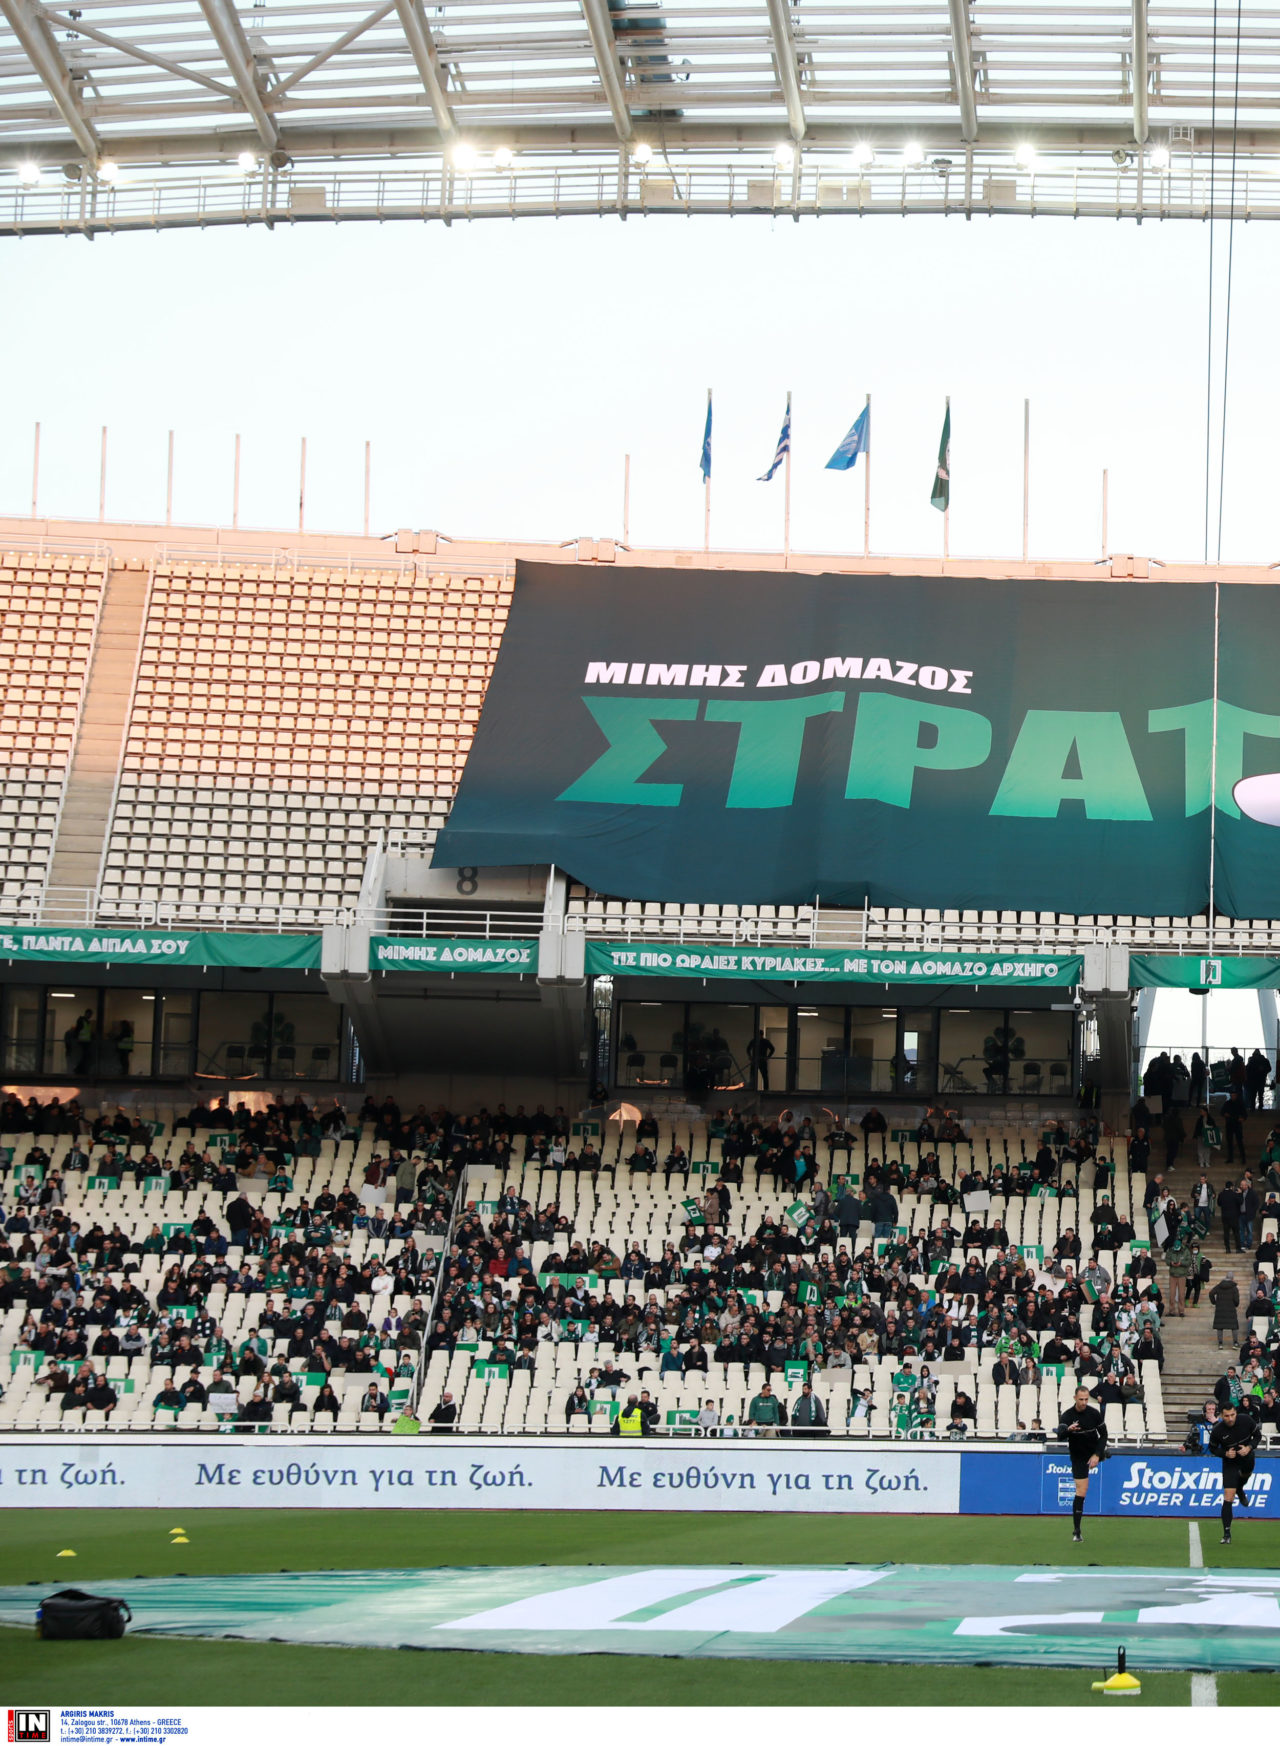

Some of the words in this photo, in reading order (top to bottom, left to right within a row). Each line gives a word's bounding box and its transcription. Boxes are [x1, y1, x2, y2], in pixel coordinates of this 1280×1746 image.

[585, 661, 748, 688] ΜΙΜΗΣ
[756, 656, 974, 695] ΔΟΜΑΖΟΣ
[456, 867, 479, 895] 8
[22, 936, 85, 951] ΠΑΝΤΑ
[88, 938, 147, 953] ΔΙΠΛΑ
[150, 939, 190, 954] ΣΟΥ
[378, 945, 437, 960] ΜΙΜΗΣ
[440, 947, 531, 963] ΔΟΜΑΖΟΣ
[611, 951, 637, 966] ΤΙΣ
[640, 953, 672, 967] ΠΙΟ
[676, 954, 738, 970] ΩΡΑΙΕΣ
[741, 956, 840, 973] ΚΥΡΙΑΚΕΣ...
[844, 958, 867, 973] ΜΕ
[871, 959, 907, 974] ΤΟΝ
[910, 960, 987, 976] ΔΟΜΑΖΟ
[990, 962, 1059, 977] ΑΡΧΗΓΟ
[17, 1468, 48, 1486] τη
[62, 1463, 126, 1489] ζωή.
[195, 1463, 241, 1486] Με
[253, 1462, 358, 1486] ευθύνη
[370, 1469, 414, 1492] για
[427, 1469, 457, 1486] τη
[470, 1463, 533, 1490] ζωή.
[597, 1465, 642, 1488] Με
[653, 1465, 756, 1489] ευθύνη
[767, 1472, 811, 1495] για
[822, 1474, 854, 1491] τη
[865, 1468, 929, 1494] ζωή.
[1046, 1464, 1099, 1474] Stoixn
[1120, 1492, 1184, 1506] SUPER
